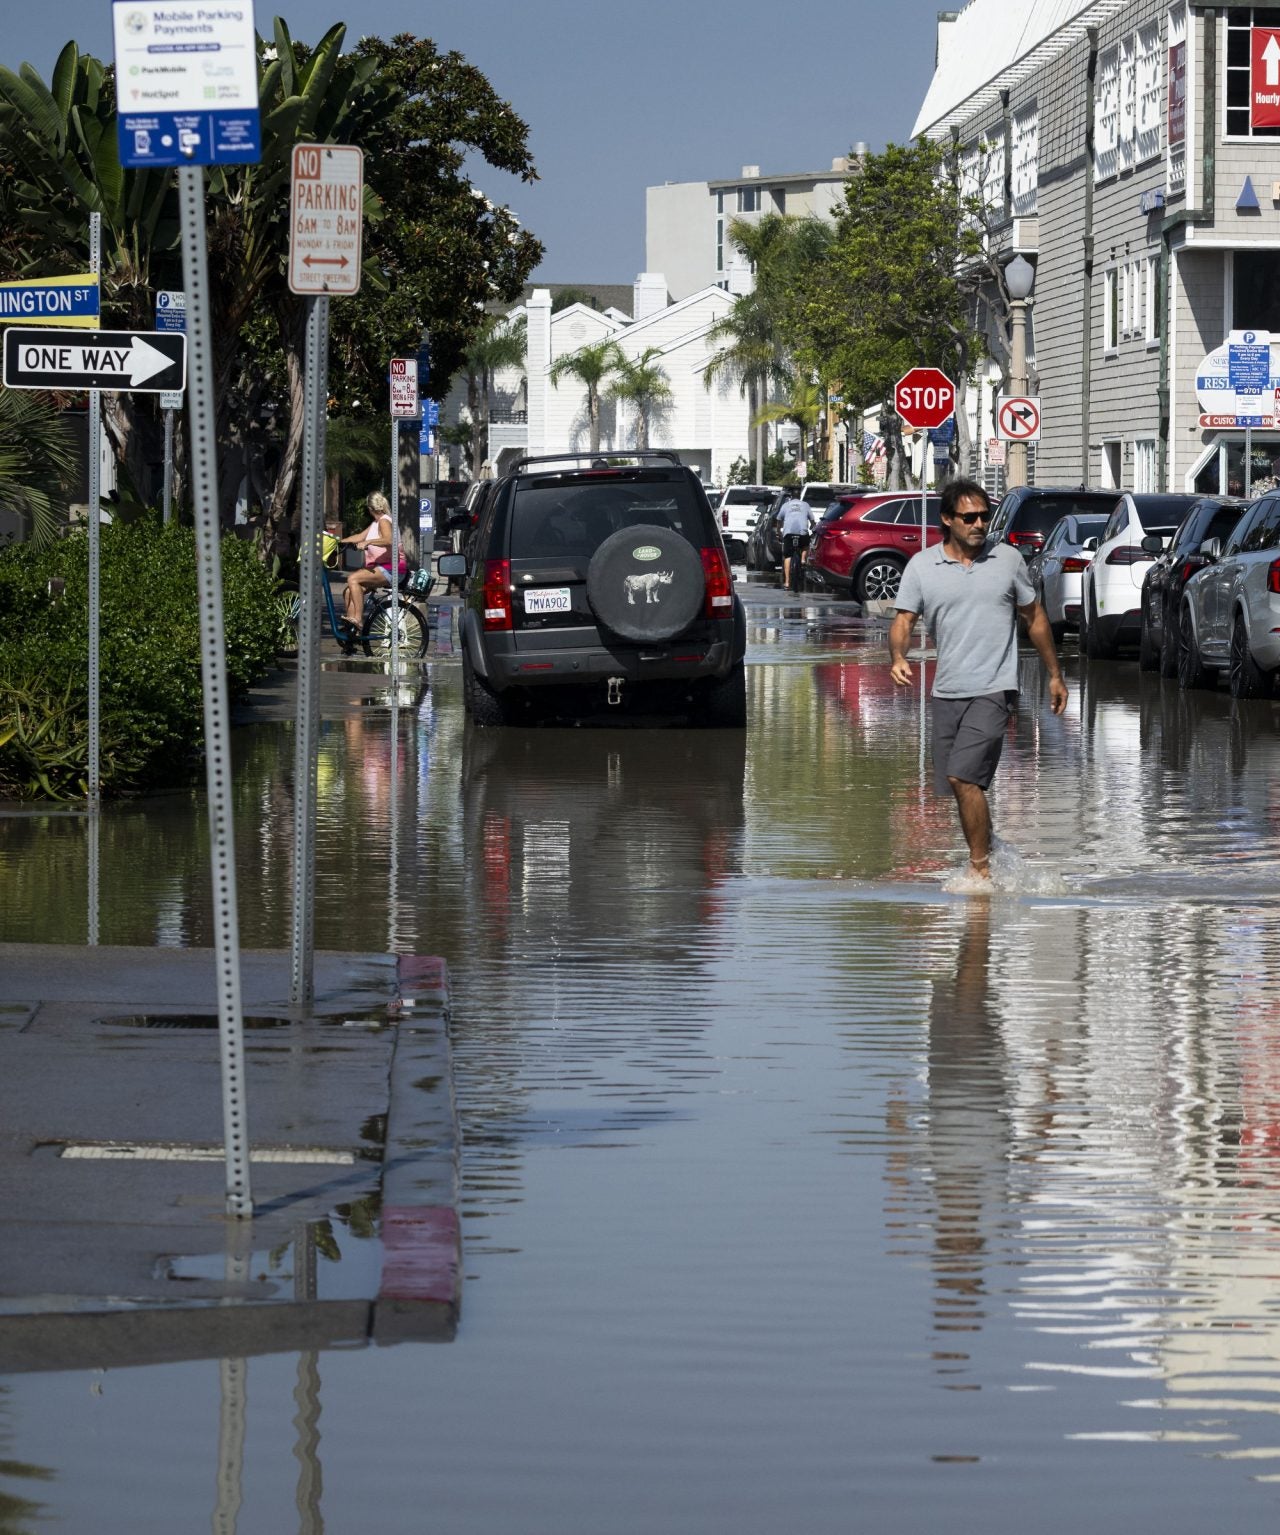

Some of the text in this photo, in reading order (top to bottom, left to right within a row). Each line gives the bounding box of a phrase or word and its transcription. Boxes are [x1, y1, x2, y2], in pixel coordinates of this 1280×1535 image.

[154, 10, 243, 21] Mobile Parking
[154, 24, 214, 36] Payments
[1256, 92, 1280, 106] Hourly
[299, 150, 318, 176] NO
[298, 184, 356, 212] PARKING
[297, 214, 317, 234] 6AM
[336, 214, 356, 236] 8AM
[297, 240, 322, 250] MONDAY
[333, 240, 354, 250] FRIDAY
[74, 290, 90, 301] ST
[25, 348, 130, 372] ONE WAY
[393, 362, 404, 374] NO
[900, 387, 951, 410] STOP
[528, 597, 568, 610] 7MVA902
